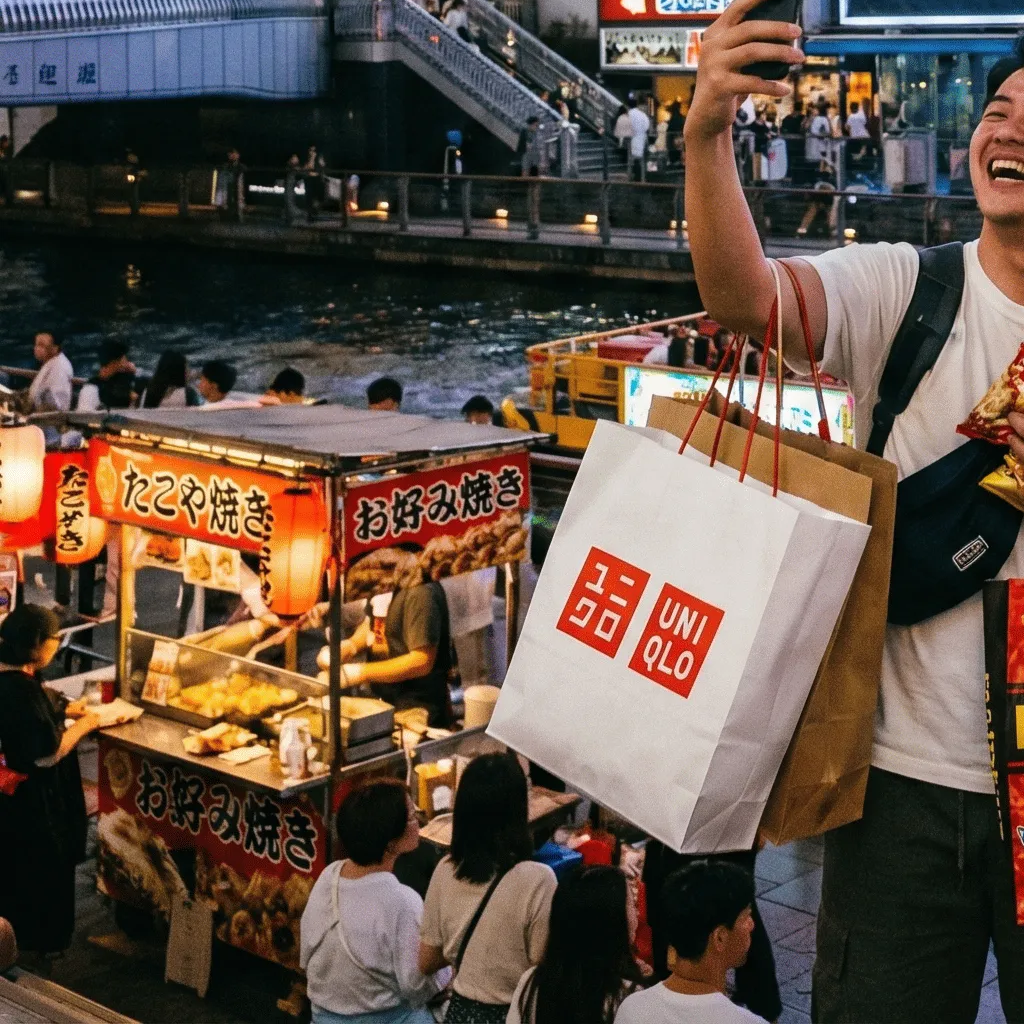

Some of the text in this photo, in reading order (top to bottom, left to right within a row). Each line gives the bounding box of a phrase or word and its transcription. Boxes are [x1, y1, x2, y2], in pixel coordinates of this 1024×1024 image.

[121, 465, 272, 539] たこや焼き
[356, 468, 522, 540] お好み焼き
[658, 597, 708, 646] UNI
[642, 635, 694, 681] QLO
[136, 760, 318, 873] お好み焼き
